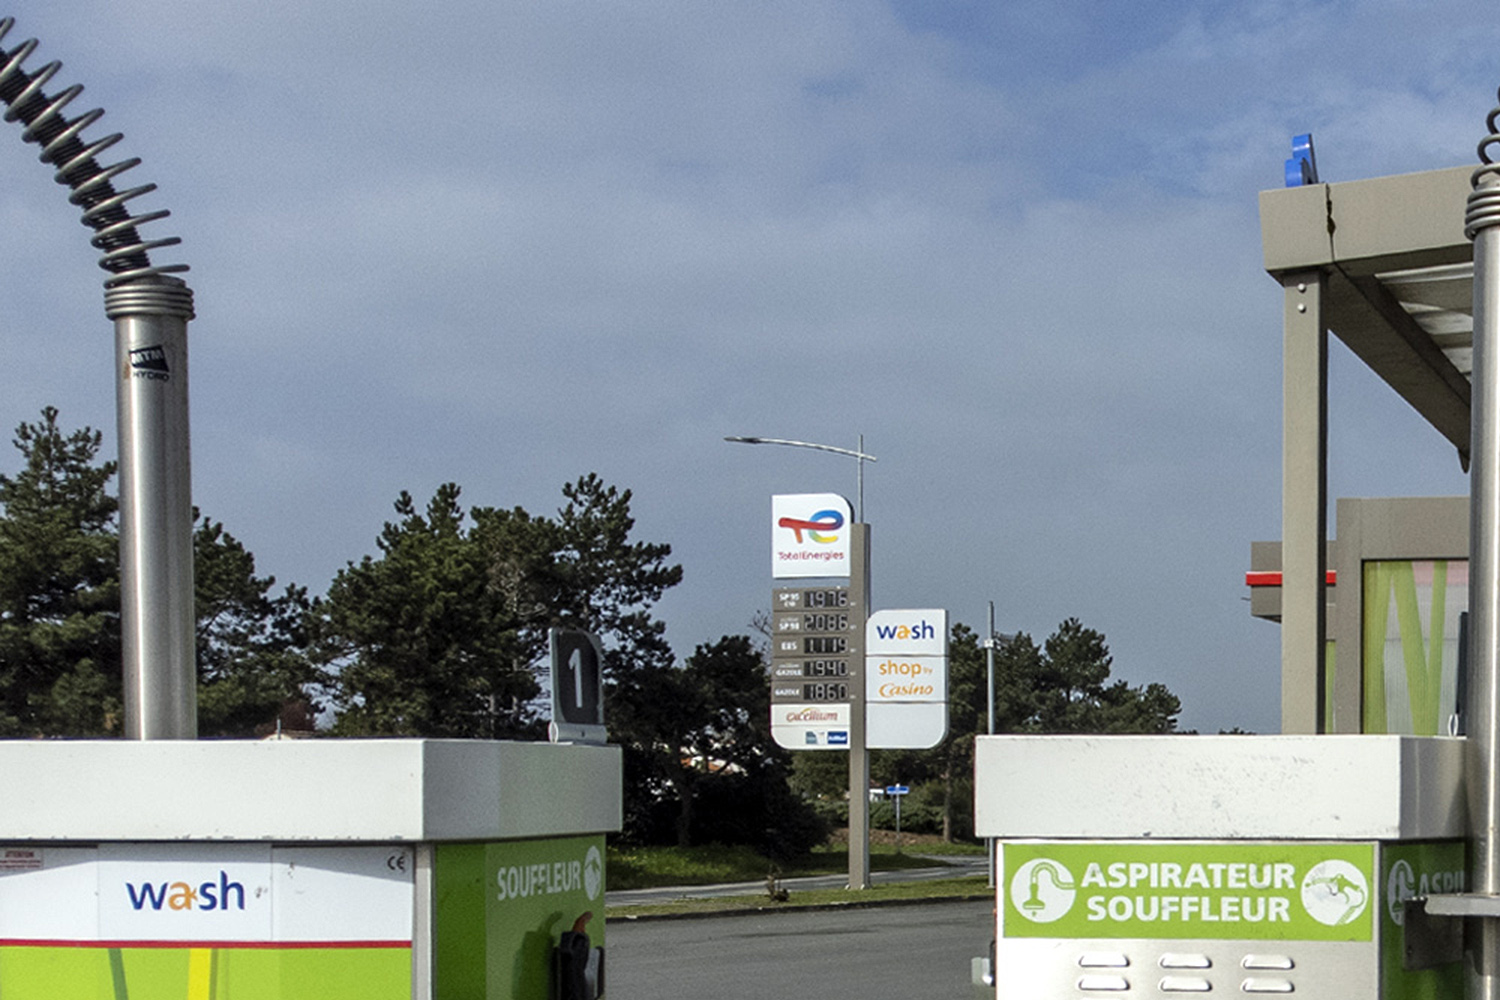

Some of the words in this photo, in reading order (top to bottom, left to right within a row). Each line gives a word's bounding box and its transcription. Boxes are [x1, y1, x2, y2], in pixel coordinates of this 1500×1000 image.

[778, 551, 845, 562] TotalEnergies
[876, 620, 935, 640] wash
[568, 648, 583, 709] 1
[879, 660, 922, 679] shop
[879, 682, 934, 698] Casino
[497, 861, 581, 901] SOUFFLEUR
[1080, 862, 1296, 889] ASPIRATEUR
[125, 870, 245, 910] wash
[1087, 895, 1290, 922] SOUFFLEUR
